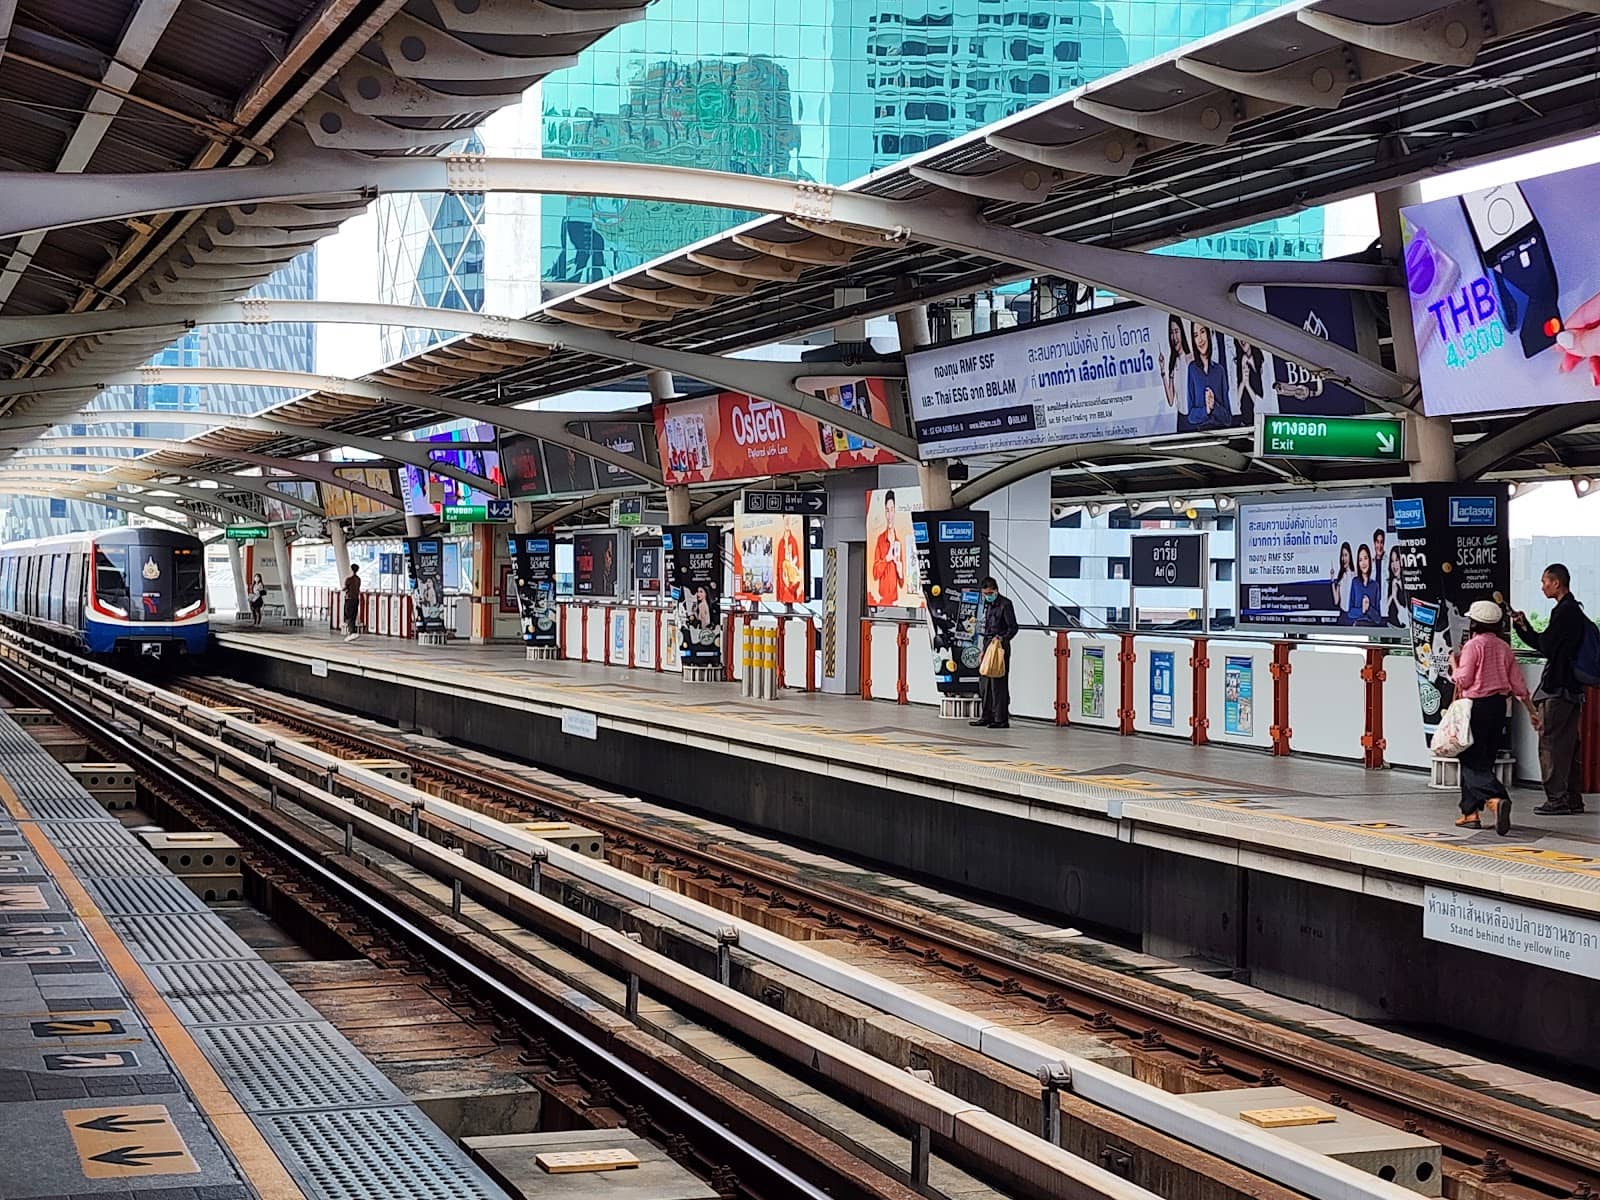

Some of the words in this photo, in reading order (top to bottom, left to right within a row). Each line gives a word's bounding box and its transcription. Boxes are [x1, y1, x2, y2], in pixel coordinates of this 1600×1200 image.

[1427, 277, 1499, 341] THB
[1102, 331, 1116, 350] กับ
[1117, 324, 1150, 347] โอกาส
[1446, 319, 1504, 369] 4,500
[934, 362, 959, 380] กองทุน
[959, 356, 978, 373] RMF
[979, 353, 995, 370] SSF
[1038, 361, 1077, 388] มากกว่า
[1079, 356, 1117, 382] เลือกได้
[1119, 348, 1154, 375] ตามใจ
[935, 388, 952, 405] Thai
[952, 385, 969, 402] ESG
[985, 378, 1017, 398] BBLAM
[1271, 421, 1327, 437] ทางออก
[1271, 438, 1294, 450] Exit
[1452, 501, 1493, 522] Lactasoy
[1153, 539, 1179, 561] อารีย์
[1457, 536, 1481, 548] BLACK
[949, 555, 981, 569] SESAME
[1456, 547, 1498, 566] SESAME
[1297, 565, 1320, 575] BBLAM
[1450, 923, 1474, 937] Stand
[1476, 927, 1505, 945] behind
[1507, 936, 1521, 949] the
[1523, 940, 1553, 955] yellow
[1554, 946, 1571, 960] line
